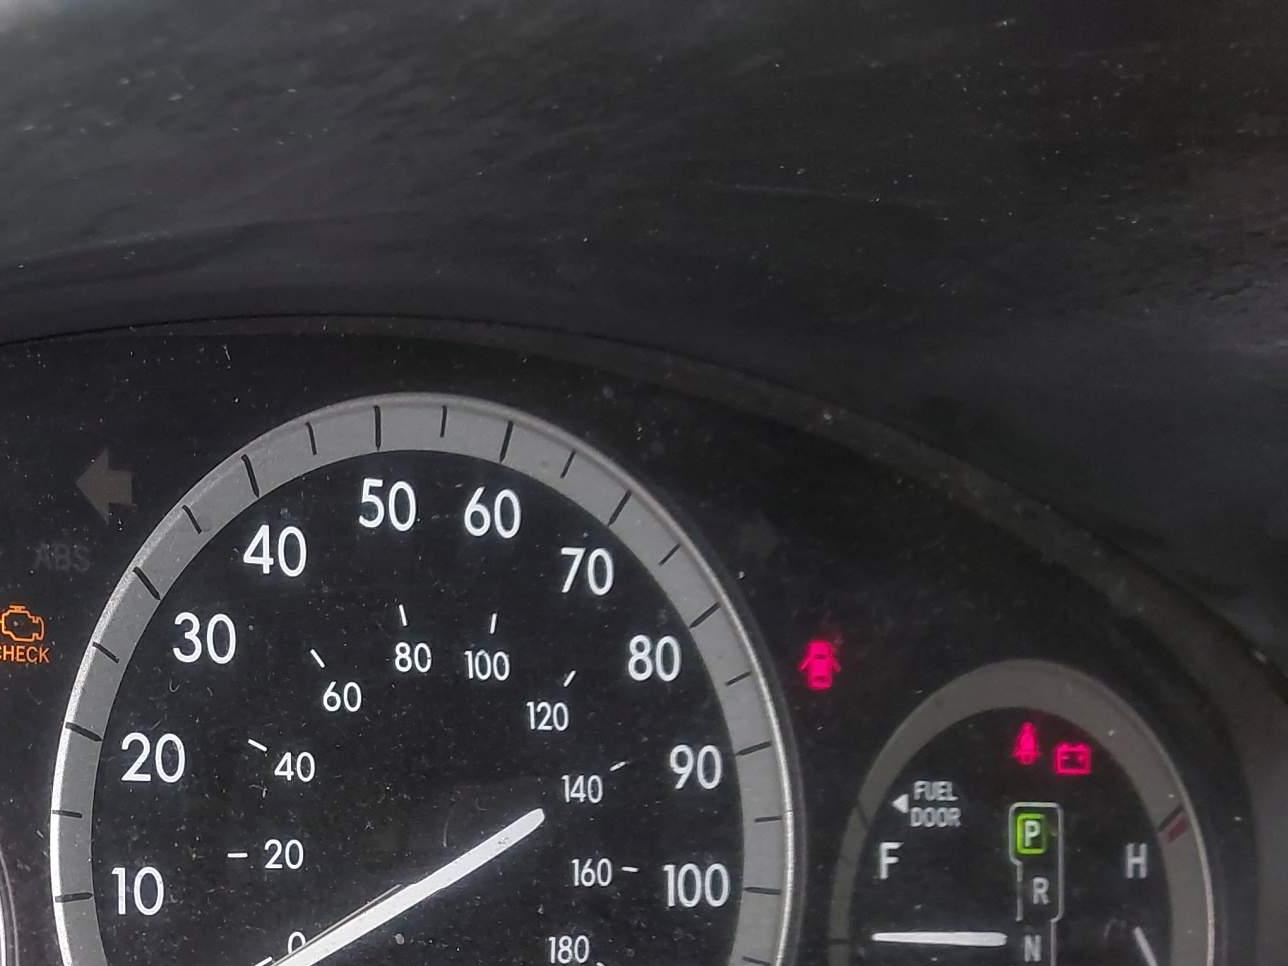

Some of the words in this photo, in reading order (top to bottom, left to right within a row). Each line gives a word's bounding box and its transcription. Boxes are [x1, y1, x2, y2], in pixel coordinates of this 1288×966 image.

[359, 479, 416, 531] 50
[464, 488, 520, 538] 60
[34, 544, 91, 573] ABS
[243, 525, 306, 576] 40
[561, 548, 613, 595] 70
[173, 612, 235, 664] 30
[395, 642, 431, 672] 80
[465, 650, 509, 680] 100
[628, 635, 680, 681] 80
[323, 682, 361, 712] 60
[527, 702, 568, 730] 120
[122, 733, 185, 782] 20
[275, 752, 315, 782] 40
[670, 745, 721, 789] 90
[562, 775, 602, 803] 140
[915, 781, 957, 801] FUEL
[911, 807, 960, 828] DOOR
[1025, 821, 1039, 847] P
[265, 839, 303, 869] 20
[880, 842, 900, 878] F
[1127, 844, 1146, 878] H
[572, 859, 611, 886] 160
[664, 864, 728, 907] 100
[112, 867, 163, 915] 10
[1033, 877, 1048, 904] R
[549, 936, 589, 963] 180
[1025, 935, 1040, 961] N
